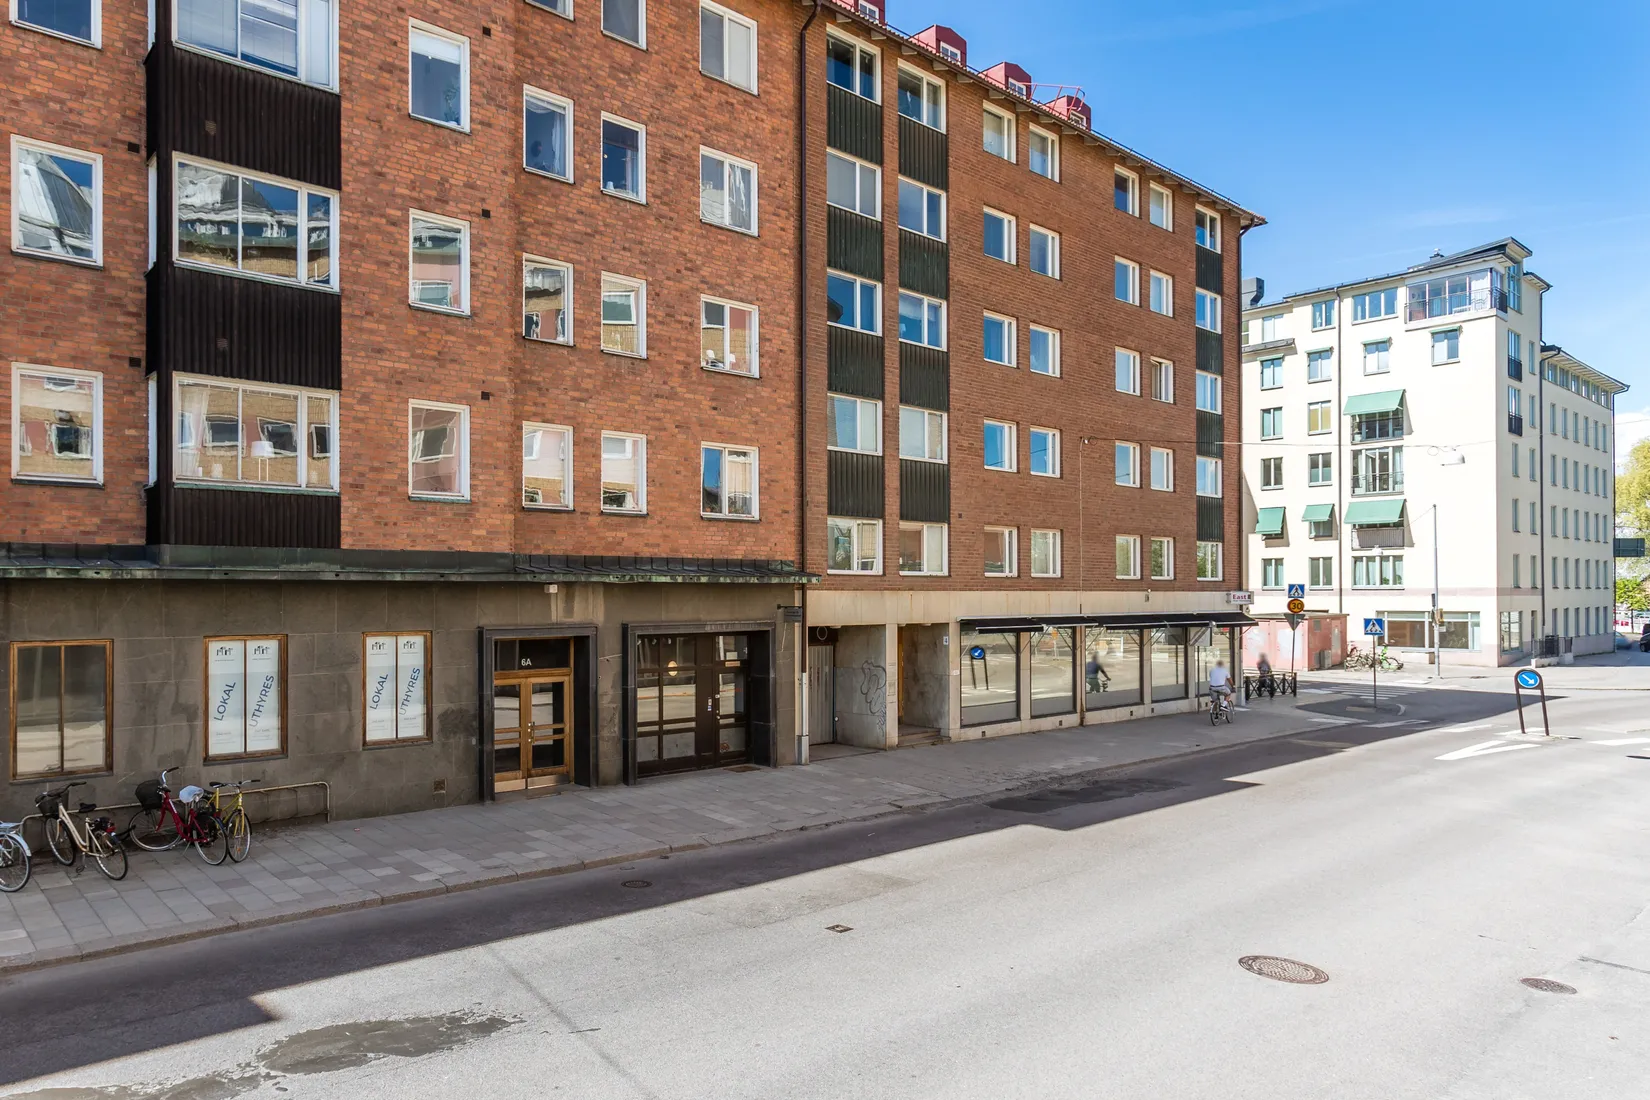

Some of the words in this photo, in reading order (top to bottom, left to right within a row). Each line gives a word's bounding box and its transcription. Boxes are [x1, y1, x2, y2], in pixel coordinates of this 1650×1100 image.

[521, 658, 532, 666] 6A
[214, 682, 236, 721] LOKAL
[249, 675, 274, 727] UTHYRES
[369, 674, 389, 710] LOKAL
[399, 667, 421, 715] UTHYRES
